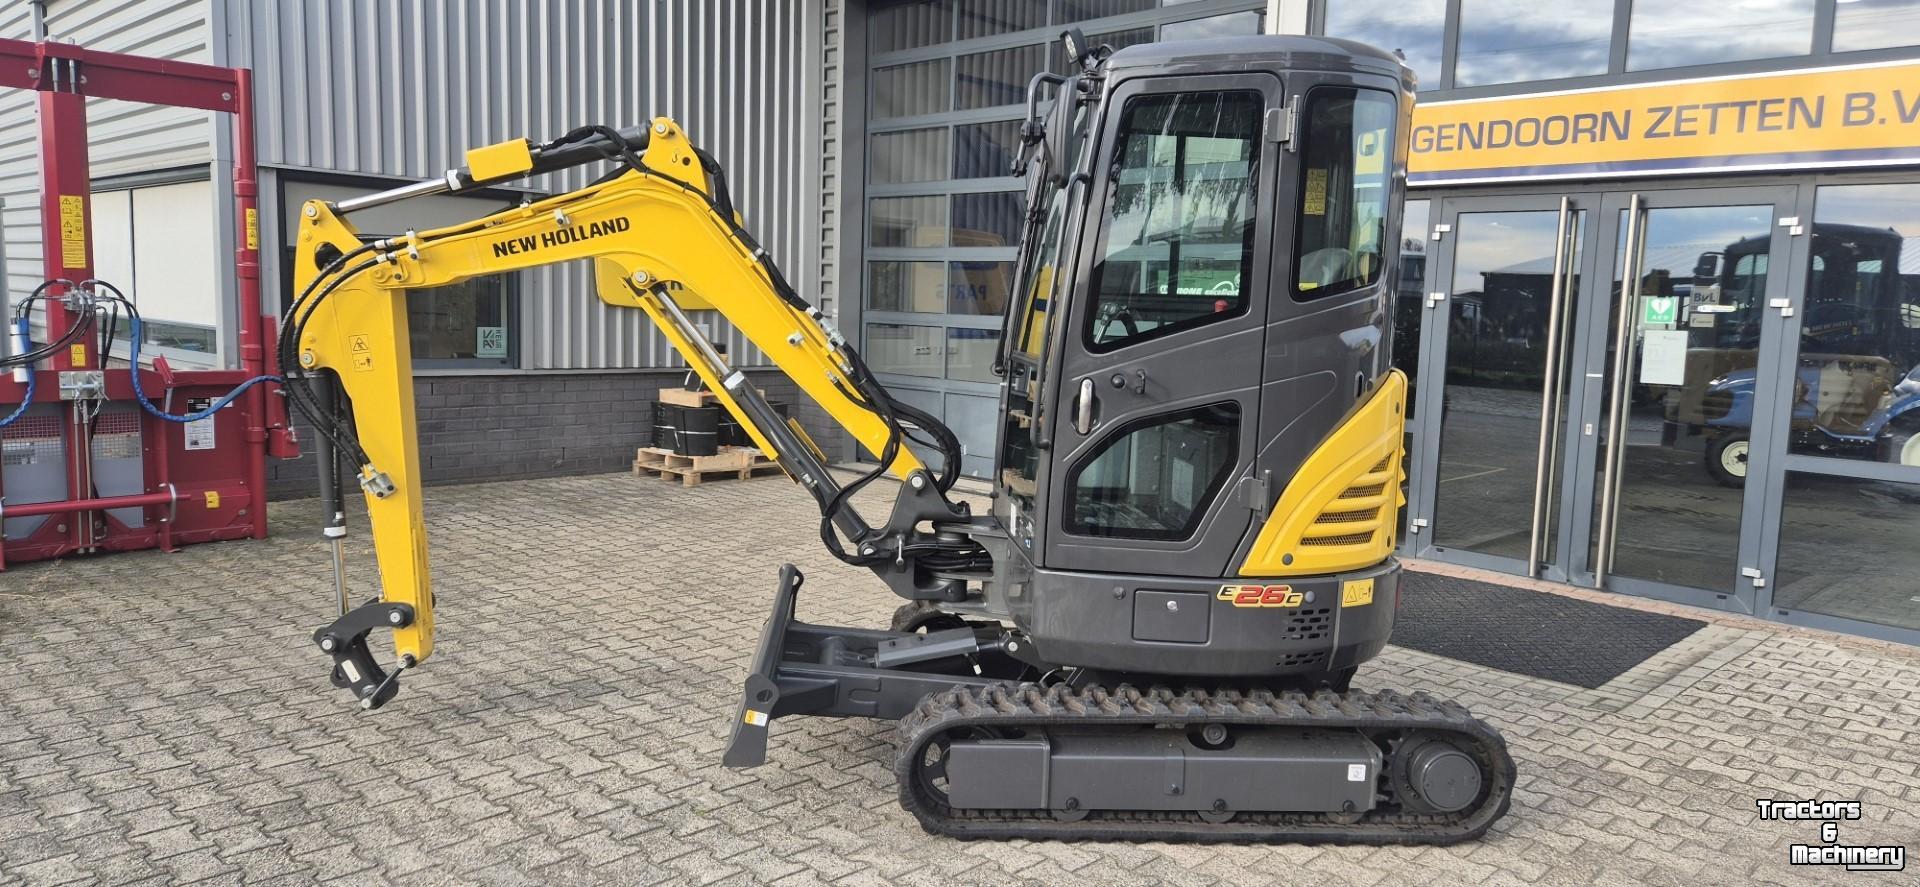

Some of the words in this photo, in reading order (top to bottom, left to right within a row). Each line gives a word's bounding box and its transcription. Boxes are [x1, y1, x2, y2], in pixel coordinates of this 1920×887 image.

[1643, 95, 1825, 139] ZETTEN
[492, 234, 537, 258] NEW
[541, 216, 630, 248] HOLLAND
